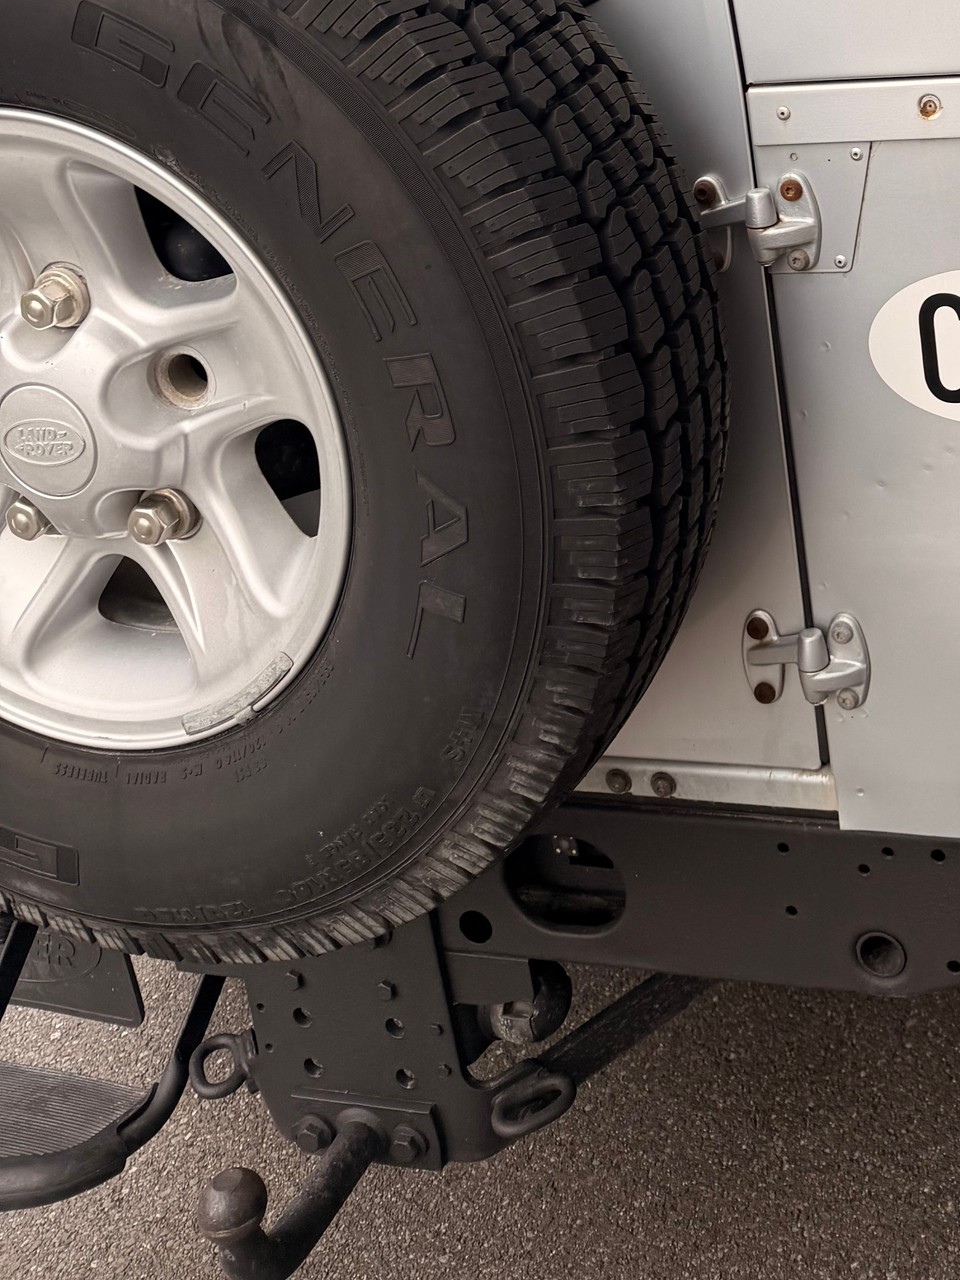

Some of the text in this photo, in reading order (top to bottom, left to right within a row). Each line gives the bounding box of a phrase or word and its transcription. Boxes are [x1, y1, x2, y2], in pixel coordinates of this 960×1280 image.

[71, 0, 468, 658] GENERAL
[55, 762, 108, 784] TUBELESS
[126, 770, 167, 785] RADIAL
